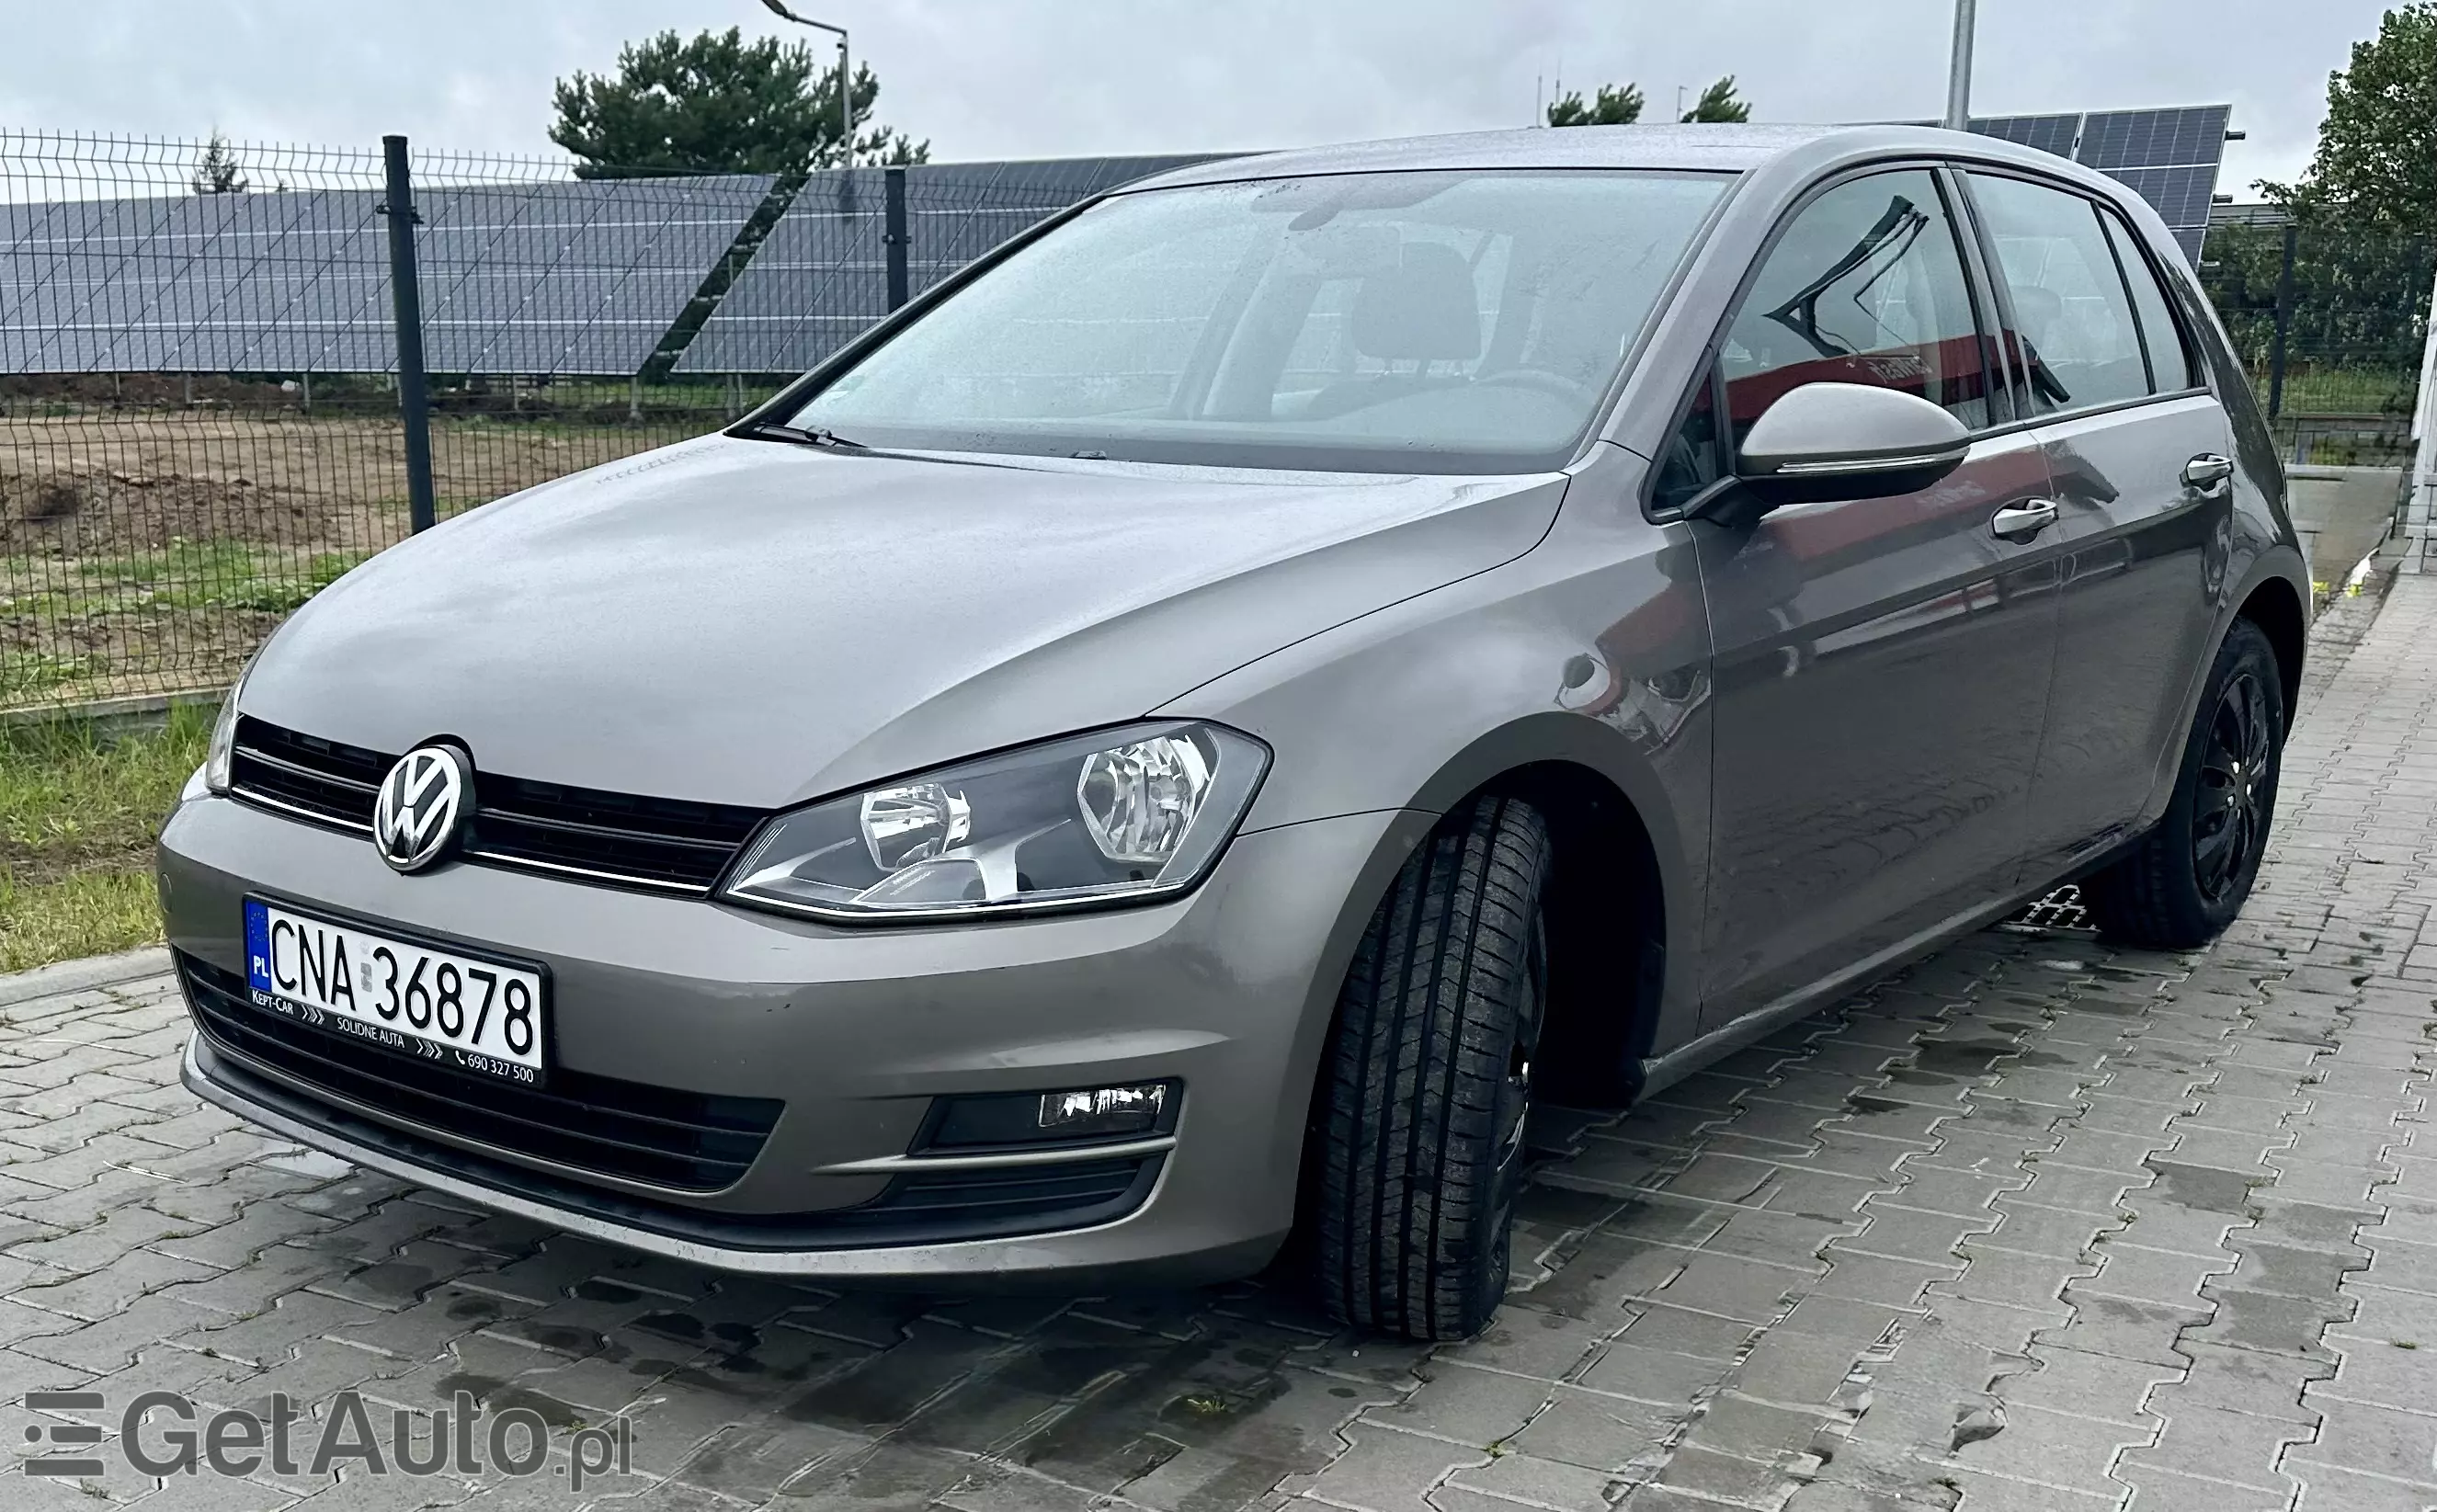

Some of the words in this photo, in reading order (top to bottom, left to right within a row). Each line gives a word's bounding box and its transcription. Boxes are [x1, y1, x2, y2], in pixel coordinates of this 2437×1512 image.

[253, 955, 269, 978] PL
[271, 919, 357, 1012] CNA
[372, 946, 534, 1056] 36878
[336, 1016, 378, 1040] SOLIDNE
[379, 1031, 405, 1049] AUTA
[467, 1054, 489, 1072] 690
[490, 1061, 510, 1076] 327
[512, 1065, 534, 1083] 500
